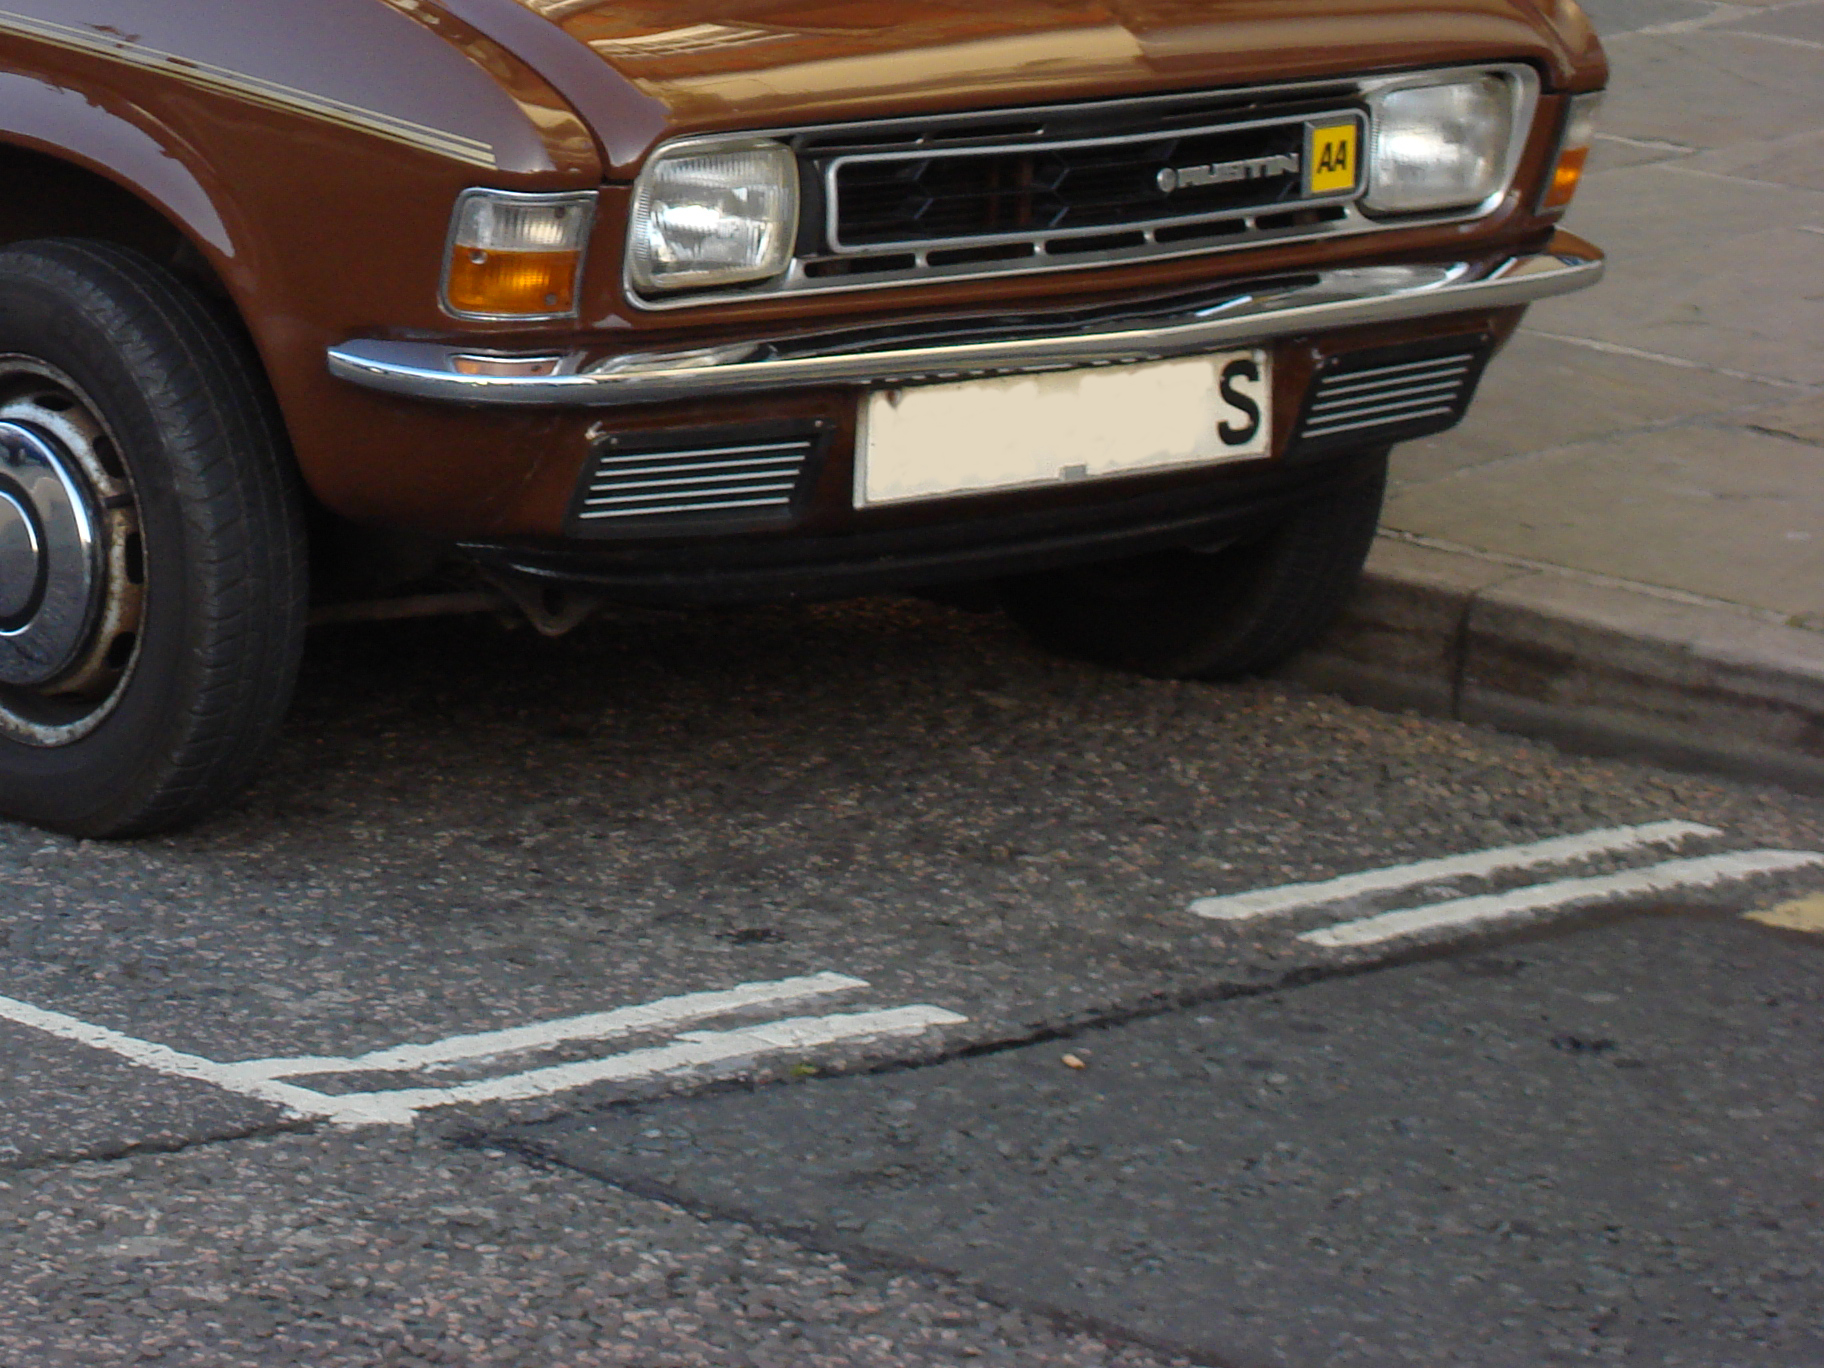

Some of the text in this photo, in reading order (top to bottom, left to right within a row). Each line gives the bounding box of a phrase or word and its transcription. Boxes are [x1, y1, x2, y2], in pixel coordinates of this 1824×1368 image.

[1177, 152, 1300, 189] AUSTIN
[1316, 139, 1348, 174] AA
[1217, 358, 1260, 446] S
